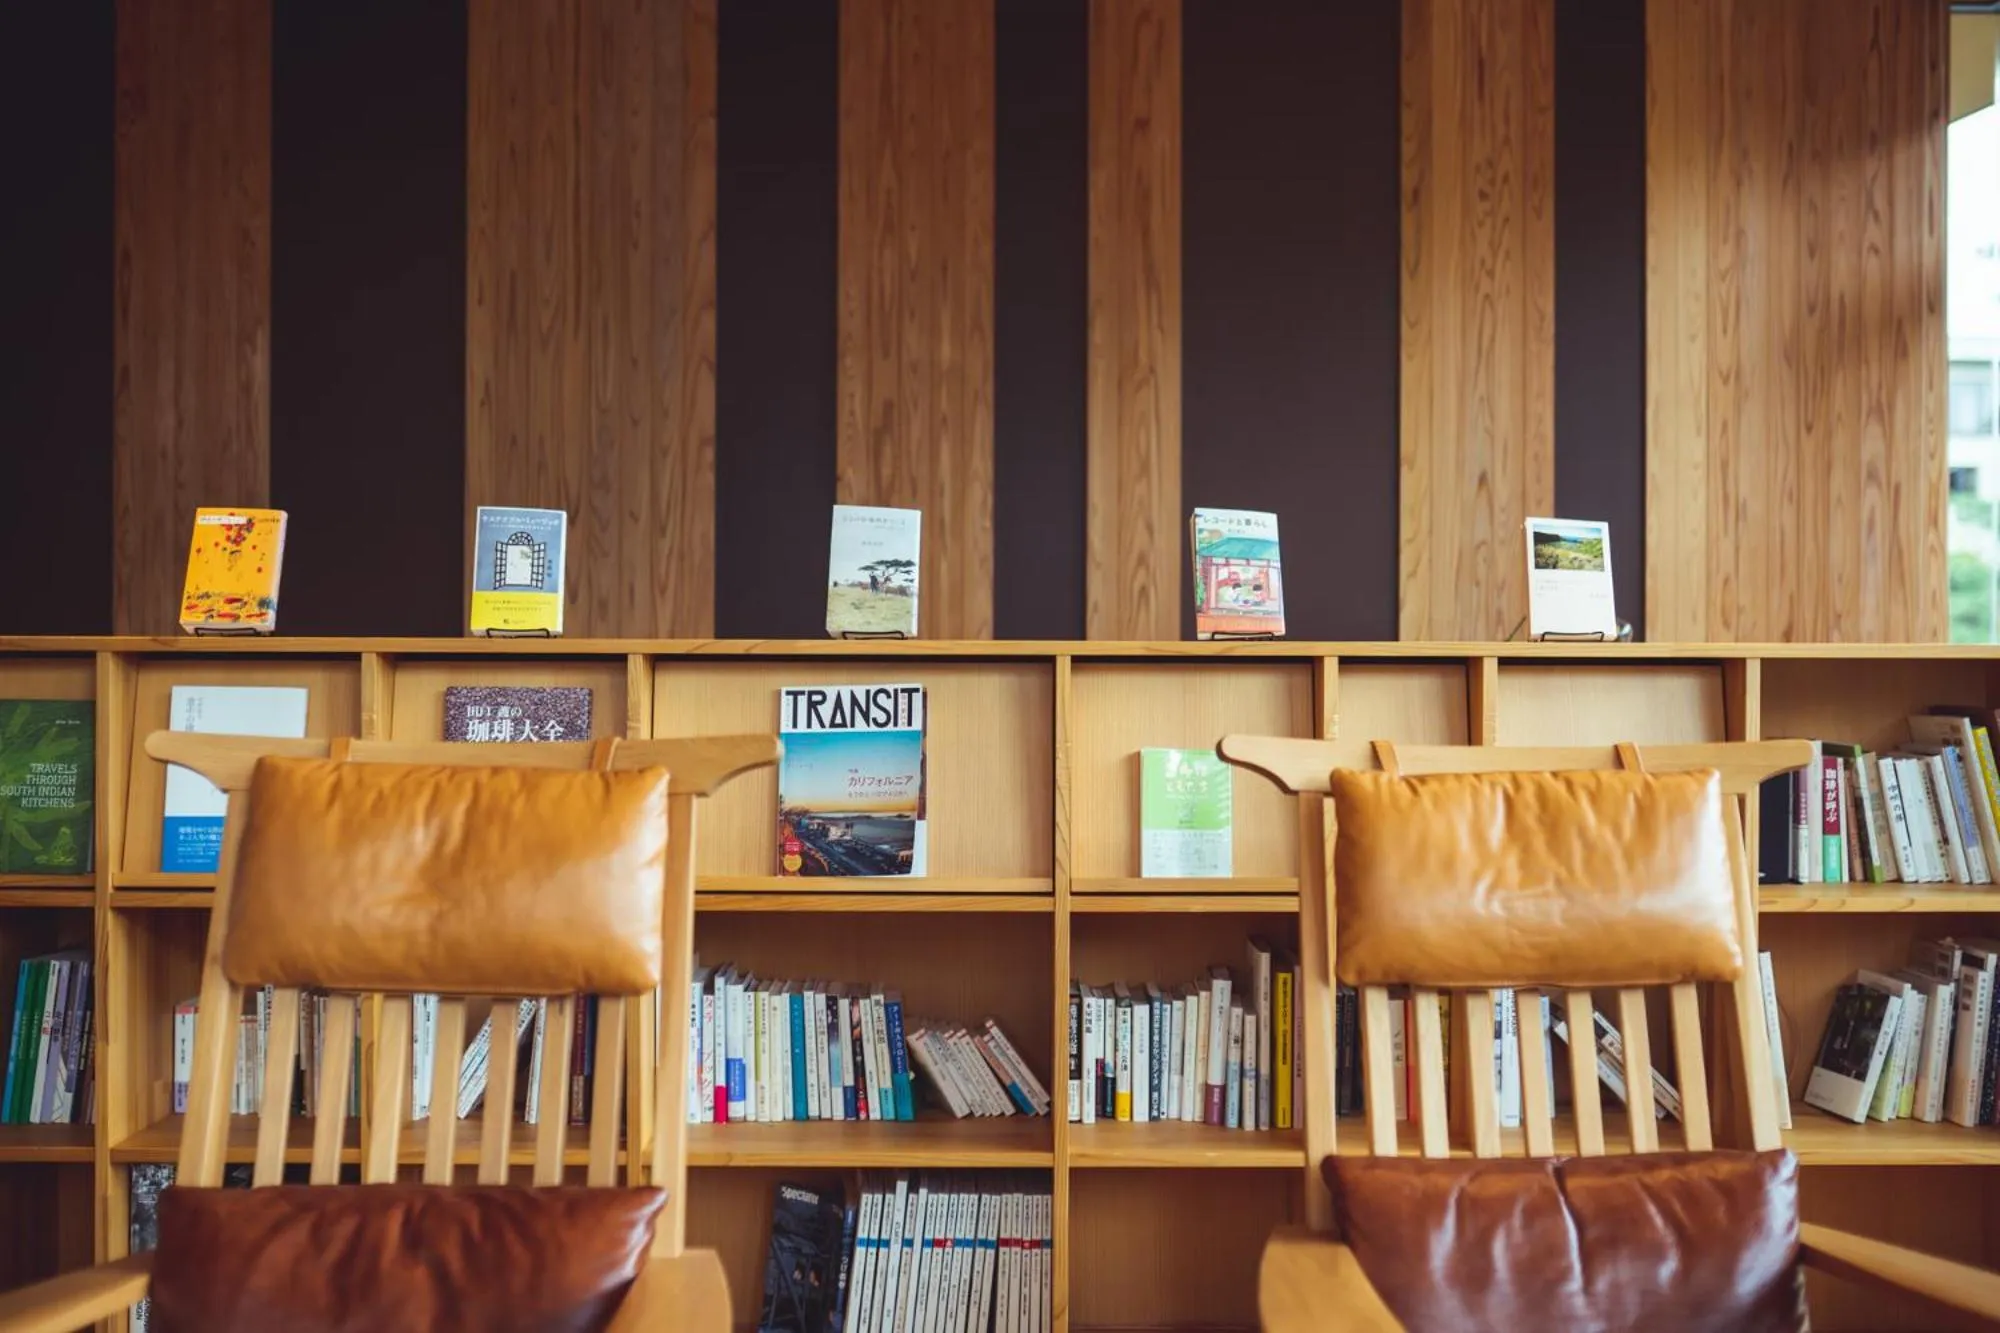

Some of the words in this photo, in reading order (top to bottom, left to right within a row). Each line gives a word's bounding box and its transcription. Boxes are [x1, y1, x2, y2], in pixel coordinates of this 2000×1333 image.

[1203, 515, 1269, 529] レコードと暮らし
[785, 687, 920, 729] TRANSIT
[466, 719, 565, 743] 珈琲大全
[29, 763, 78, 774] TRAVELS
[26, 774, 77, 786] THROUGH
[848, 775, 914, 788] カリフォルニア
[0, 785, 36, 797] SOUTH
[38, 785, 76, 797] INDIAN
[1825, 768, 1838, 823] 珈琲が呼ぶ
[21, 796, 76, 809] KITCHENS
